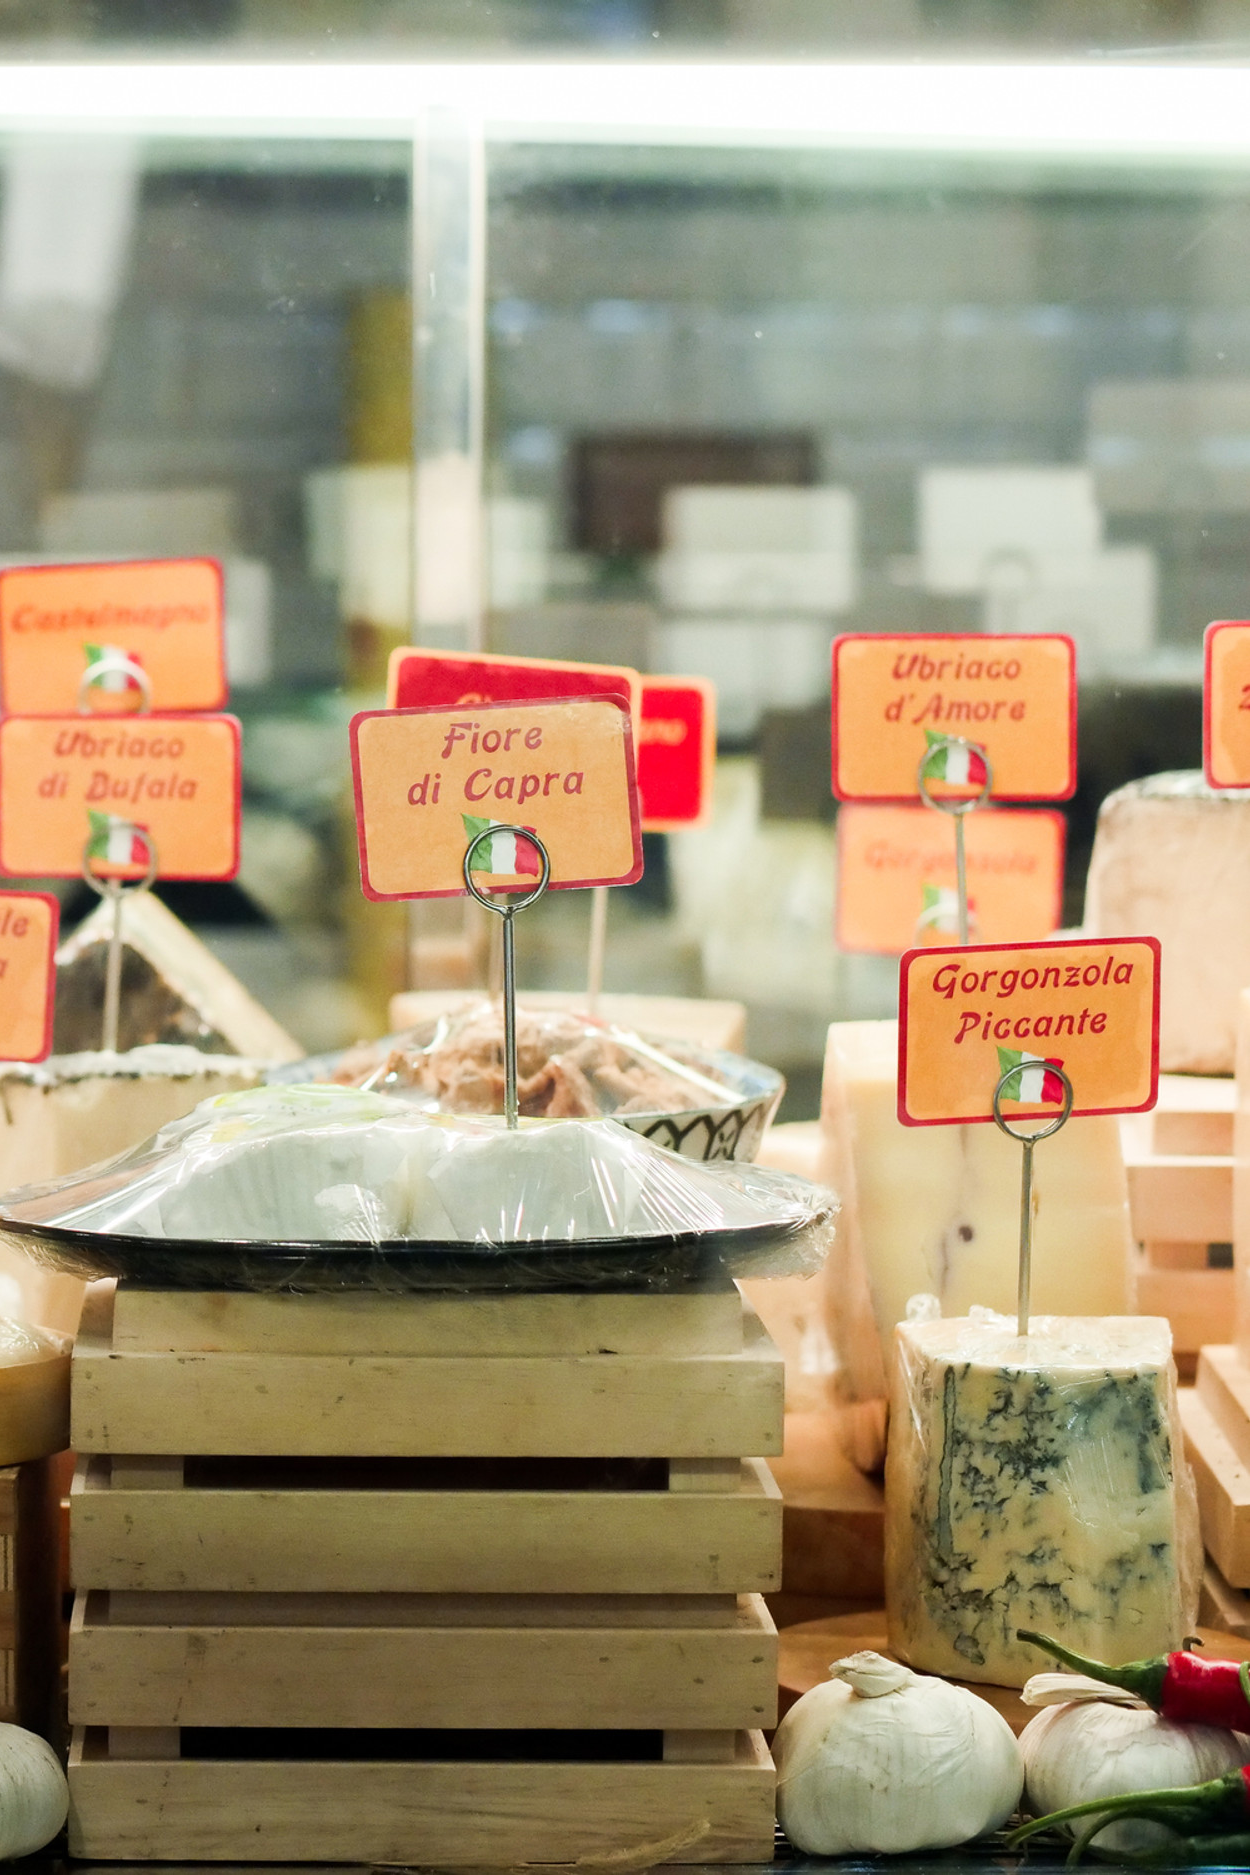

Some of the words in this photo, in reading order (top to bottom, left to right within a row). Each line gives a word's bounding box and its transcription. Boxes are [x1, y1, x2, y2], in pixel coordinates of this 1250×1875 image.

[891, 653, 1021, 682] Ubriaco
[885, 693, 1026, 725] d'Amore
[54, 731, 184, 759] Ubriaco
[440, 721, 543, 759] Fiore
[37, 772, 69, 799] di
[85, 770, 199, 804] Bufala
[407, 774, 440, 805] di
[463, 767, 585, 804] Capra
[932, 956, 1134, 999] Gorgonzola
[954, 1007, 1108, 1044] Piccante
